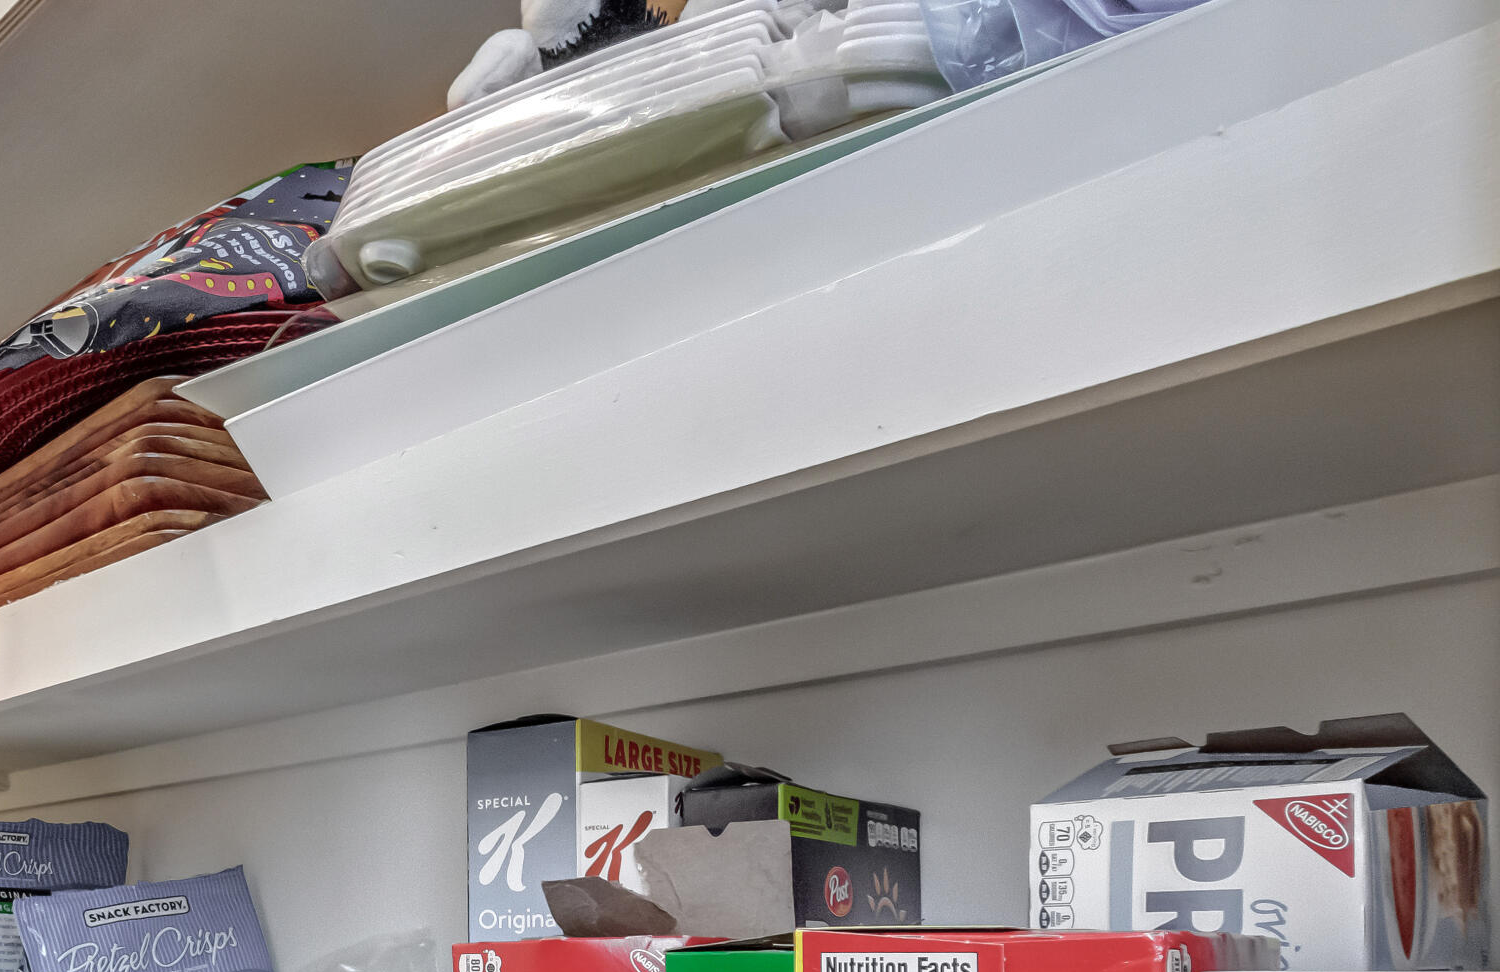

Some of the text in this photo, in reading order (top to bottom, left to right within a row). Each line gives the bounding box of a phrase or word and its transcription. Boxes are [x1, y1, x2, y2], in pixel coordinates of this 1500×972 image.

[603, 734, 664, 772] LARGE
[477, 795, 531, 811] SPECIAL
[584, 823, 611, 832] SPECIAL
[1056, 826, 1071, 841] 70
[1289, 803, 1345, 846] NABISCO
[477, 792, 564, 892] K
[3, 851, 53, 882] Crisps
[828, 874, 850, 906] Post
[88, 900, 184, 923] SNACK FACTORY
[478, 908, 557, 934] Origina
[152, 926, 238, 967] Crisps
[471, 958, 480, 972] 80
